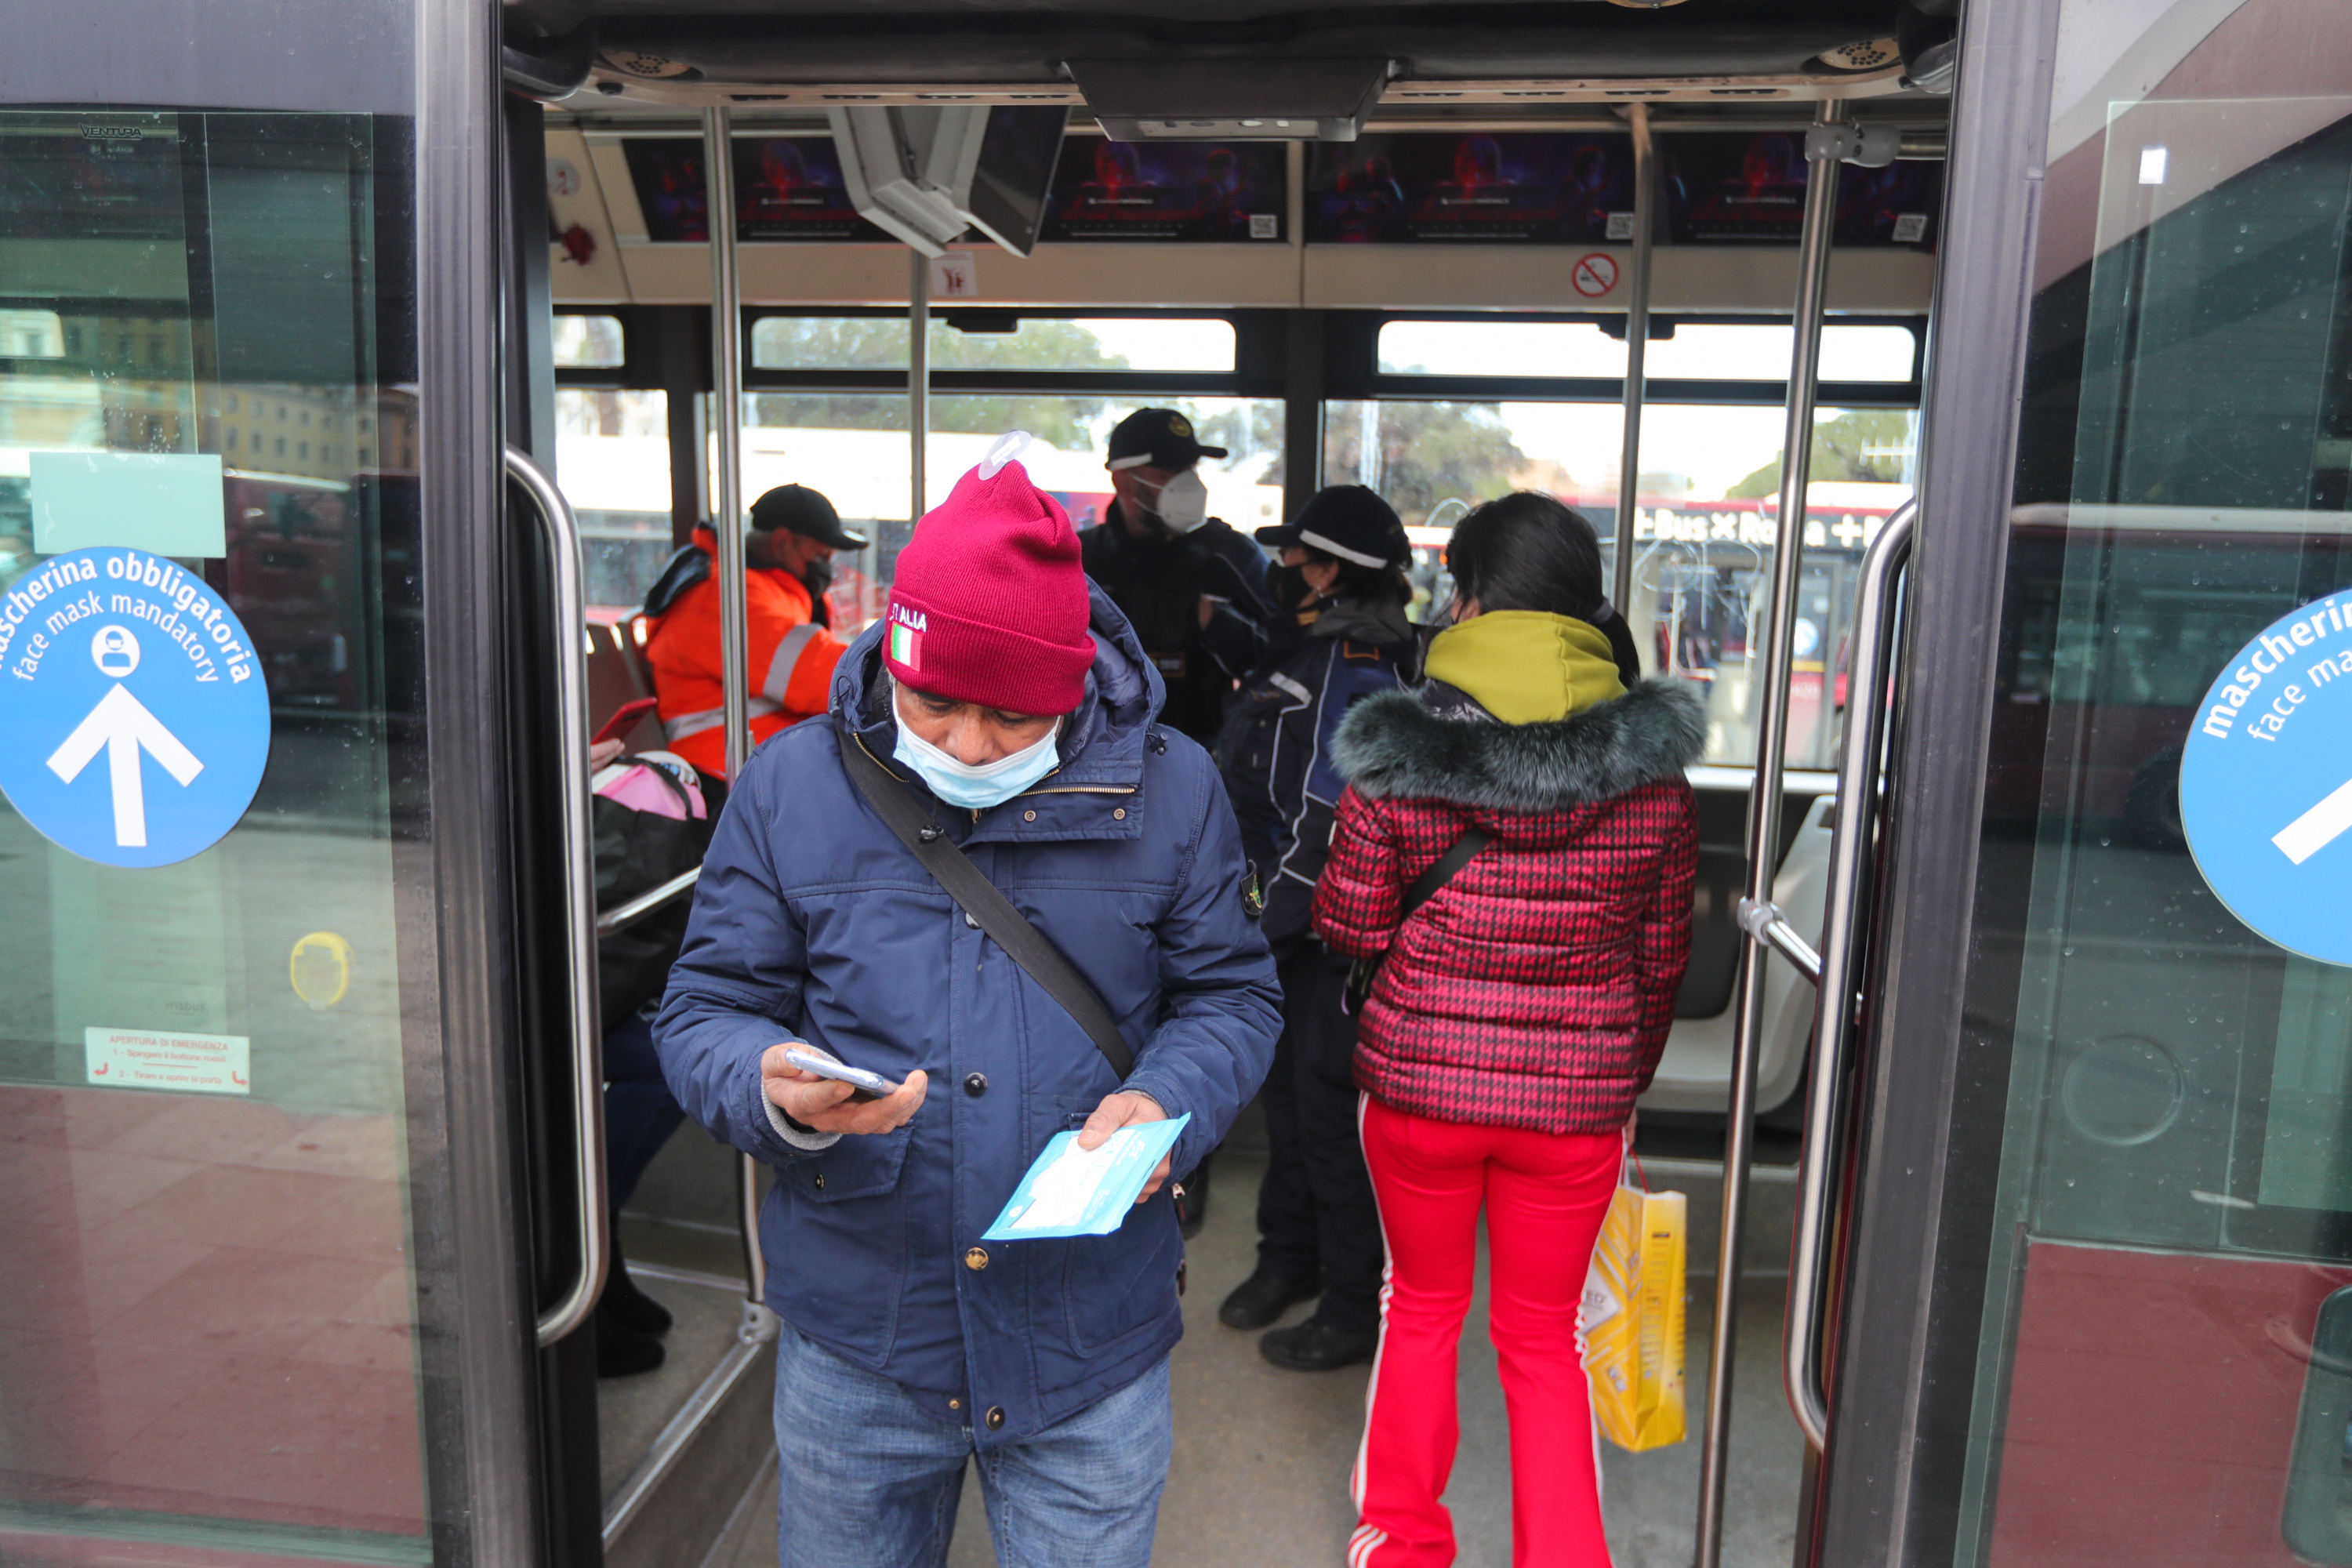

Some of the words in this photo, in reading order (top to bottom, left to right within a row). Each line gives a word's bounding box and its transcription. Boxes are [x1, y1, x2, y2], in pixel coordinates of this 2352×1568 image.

[79, 123, 143, 140] VENTURA
[0, 557, 98, 670] scherina
[107, 551, 252, 684] obbligatoria
[13, 633, 50, 681] face
[45, 590, 104, 636] mask
[111, 593, 220, 682] mandatory
[2247, 684, 2307, 742] face
[110, 1036, 157, 1046] APERTURA
[160, 1038, 170, 1047] DI
[172, 1039, 228, 1051] EMERGENZA
[127, 1049, 163, 1059] Spingere
[170, 1052, 201, 1062] bottone
[134, 1071, 157, 1080] Tirare
[166, 1073, 189, 1082] aprire
[200, 1076, 222, 1084] porta
